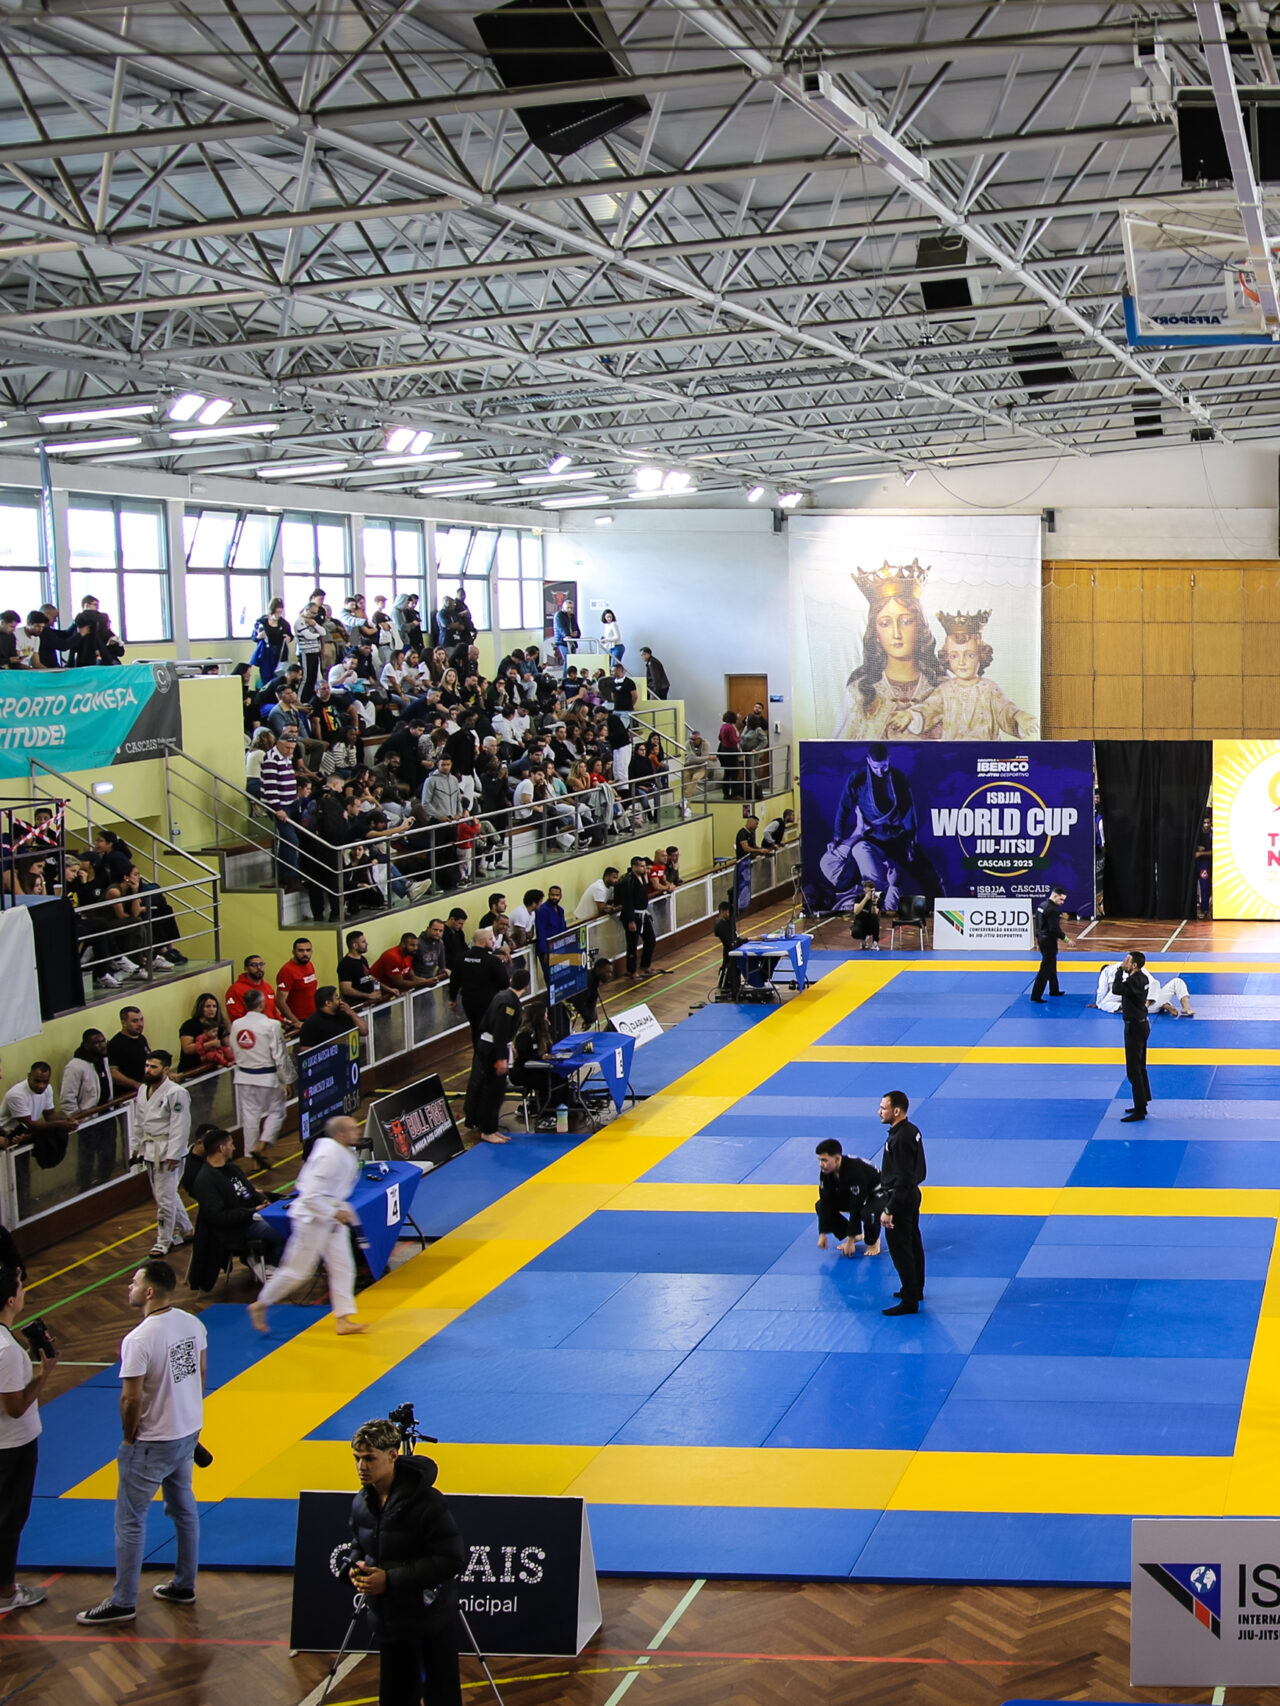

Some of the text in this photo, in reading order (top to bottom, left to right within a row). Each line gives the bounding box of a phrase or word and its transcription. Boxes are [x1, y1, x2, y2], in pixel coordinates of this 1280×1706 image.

[70, 686, 138, 713] COMEÇA
[986, 791, 1022, 805] ISBJJA
[931, 807, 1078, 837] WORLD CUP
[975, 838, 1035, 854] JIU-JITSU
[977, 859, 1034, 868] CASCAIS 2025
[976, 885, 1006, 894] ISBJJA
[1010, 884, 1051, 894] CASCAIS
[969, 910, 1030, 926] CBJJD
[405, 1109, 431, 1138] BULL
[392, 1199, 399, 1218] 4
